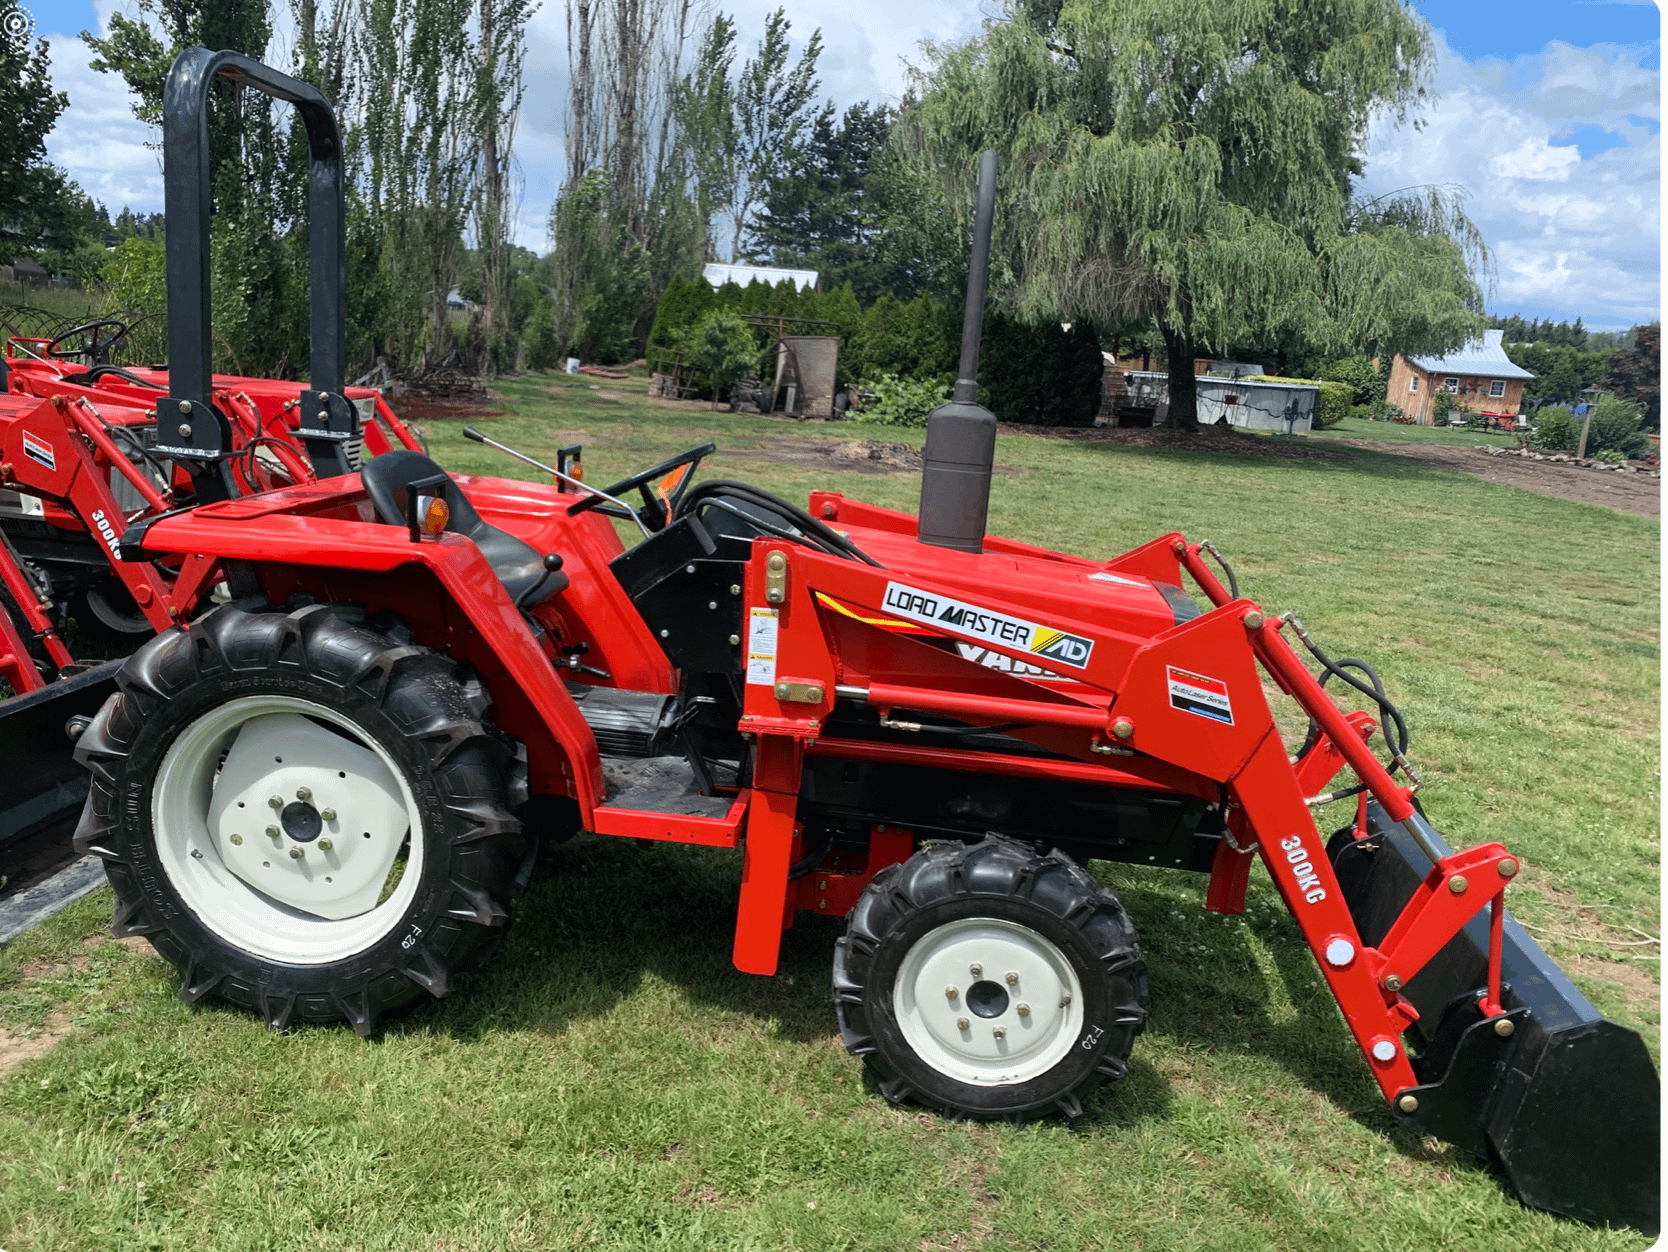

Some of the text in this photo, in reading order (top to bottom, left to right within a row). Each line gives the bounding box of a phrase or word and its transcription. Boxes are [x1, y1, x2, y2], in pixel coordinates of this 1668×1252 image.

[886, 588, 938, 618] LOAD
[937, 606, 1031, 646] MASTER
[1281, 835, 1327, 905] 300KG
